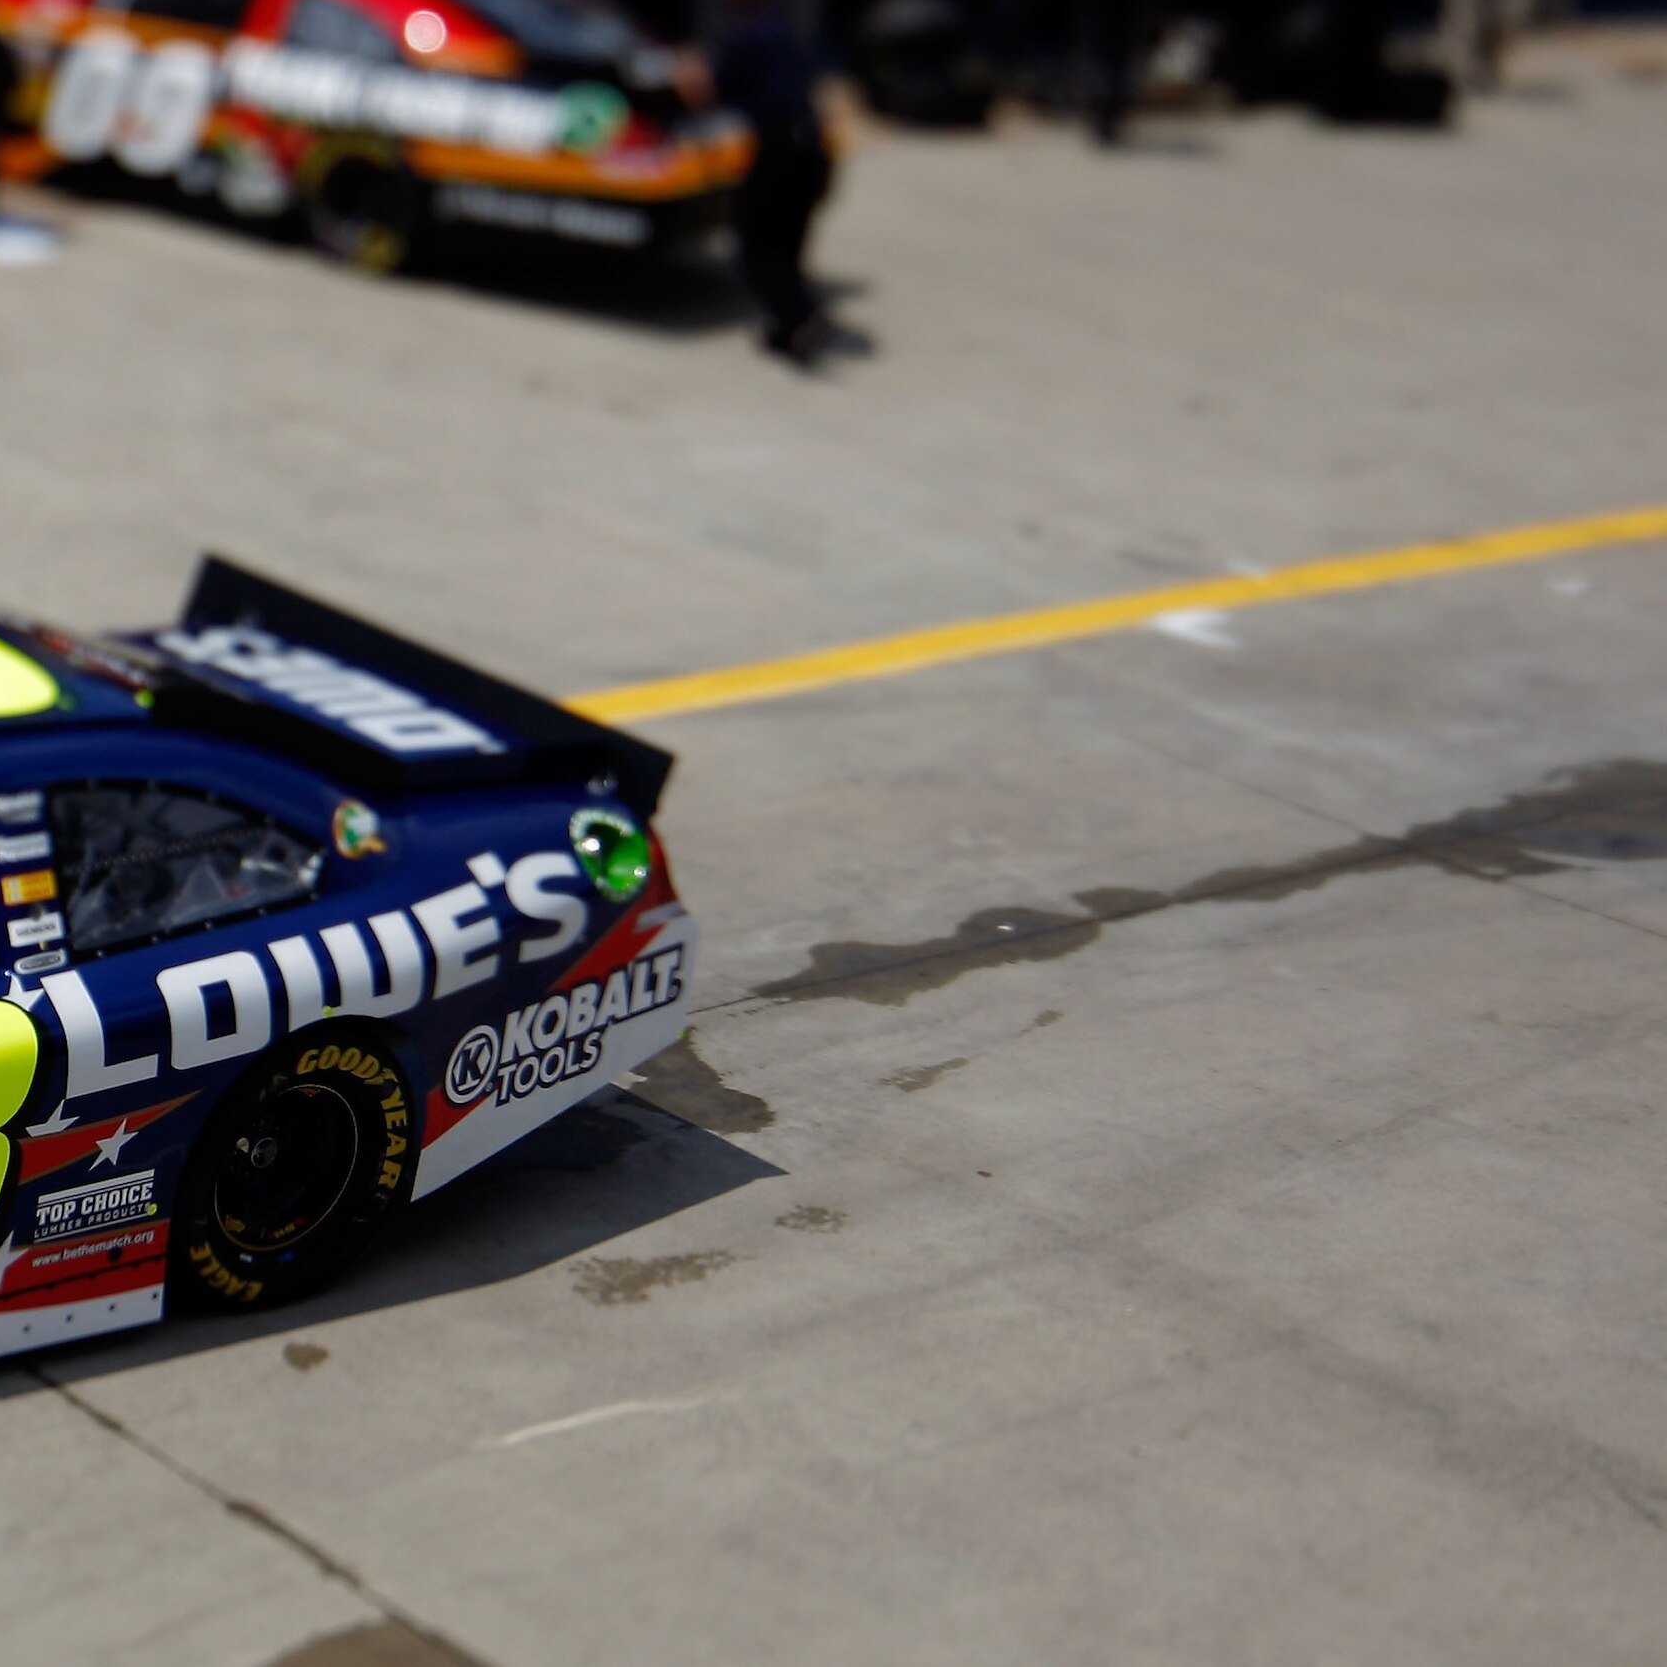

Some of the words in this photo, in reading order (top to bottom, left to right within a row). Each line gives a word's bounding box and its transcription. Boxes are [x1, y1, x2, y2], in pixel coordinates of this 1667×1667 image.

[42, 851, 589, 1098] LOWE'S
[500, 949, 680, 1064] KOBALT
[499, 1032, 602, 1102] TOOLS
[296, 1044, 408, 1190] GOODYEAR
[34, 1218, 82, 1238] LUMBER
[36, 1201, 76, 1226] TOP
[81, 1182, 154, 1215] CHOICE
[189, 1239, 264, 1304] EAGLE
